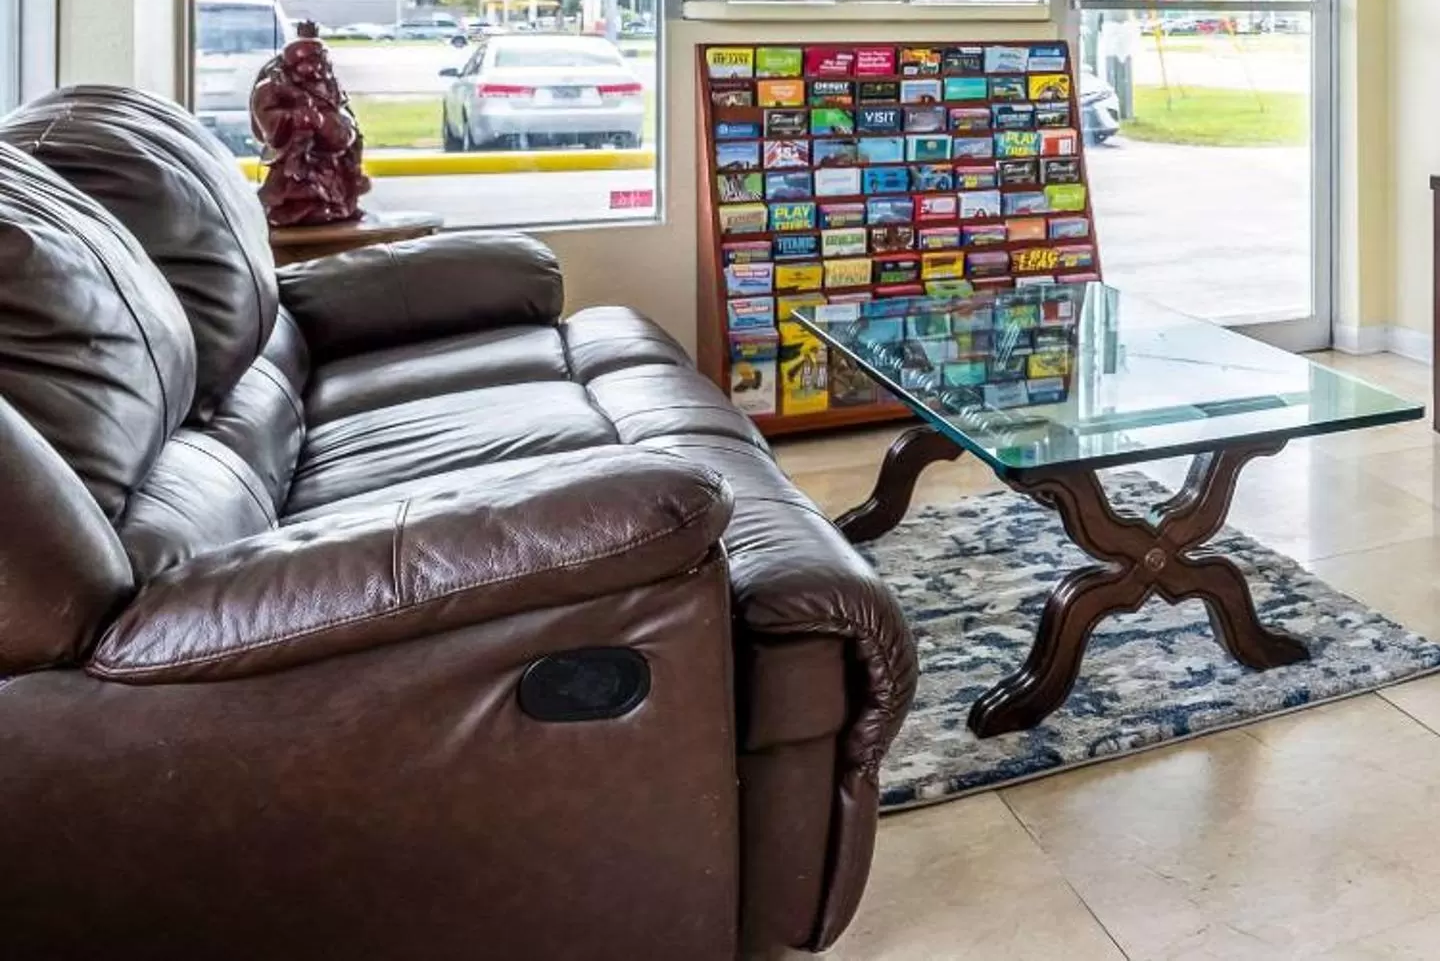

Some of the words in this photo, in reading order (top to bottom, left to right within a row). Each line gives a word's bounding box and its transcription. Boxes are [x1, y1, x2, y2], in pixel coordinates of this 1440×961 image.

[865, 111, 896, 123] VISIT
[1005, 130, 1037, 144] PLAY
[775, 205, 810, 219] PLAY
